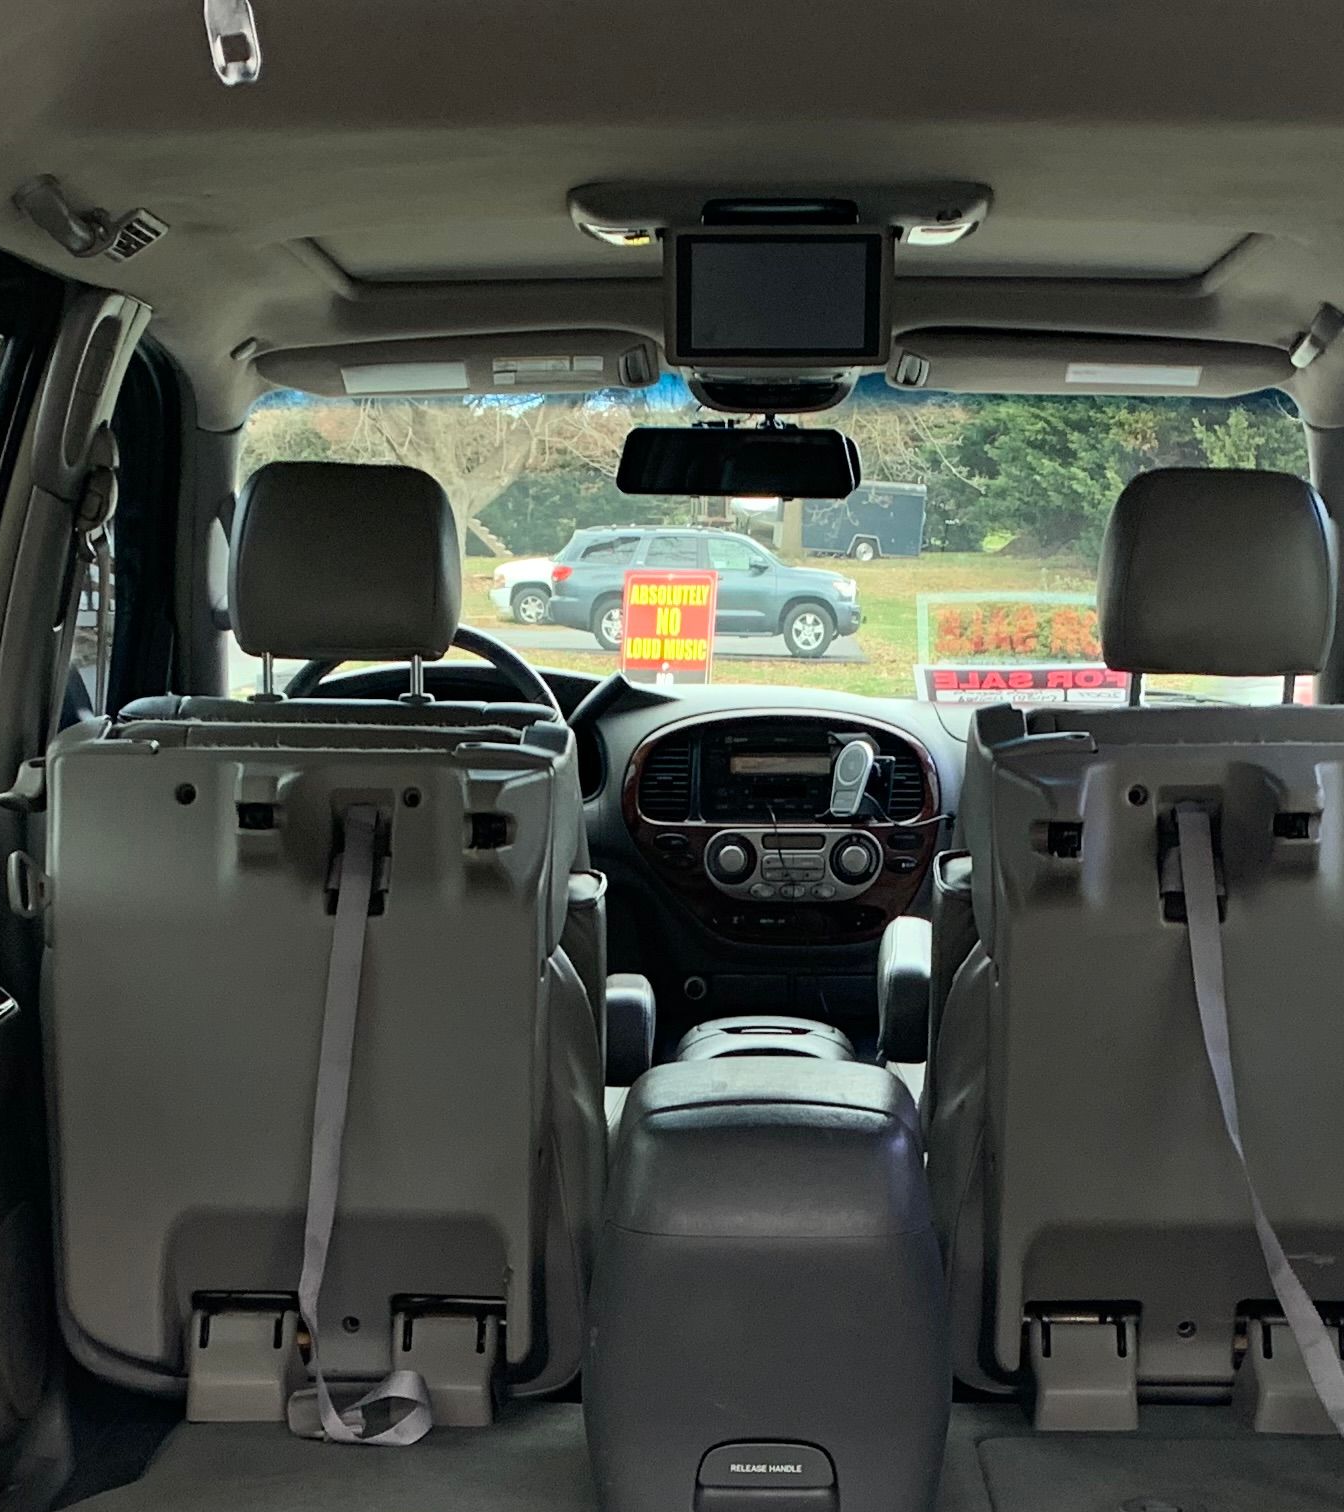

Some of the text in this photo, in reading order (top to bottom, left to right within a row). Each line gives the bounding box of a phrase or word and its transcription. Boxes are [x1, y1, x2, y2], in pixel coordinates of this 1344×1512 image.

[630, 584, 710, 605] ABSOLUTELY
[656, 607, 682, 637] NO
[626, 637, 707, 661] LOUD MUSIC
[730, 1464, 802, 1473] RELEASE HANDLE
